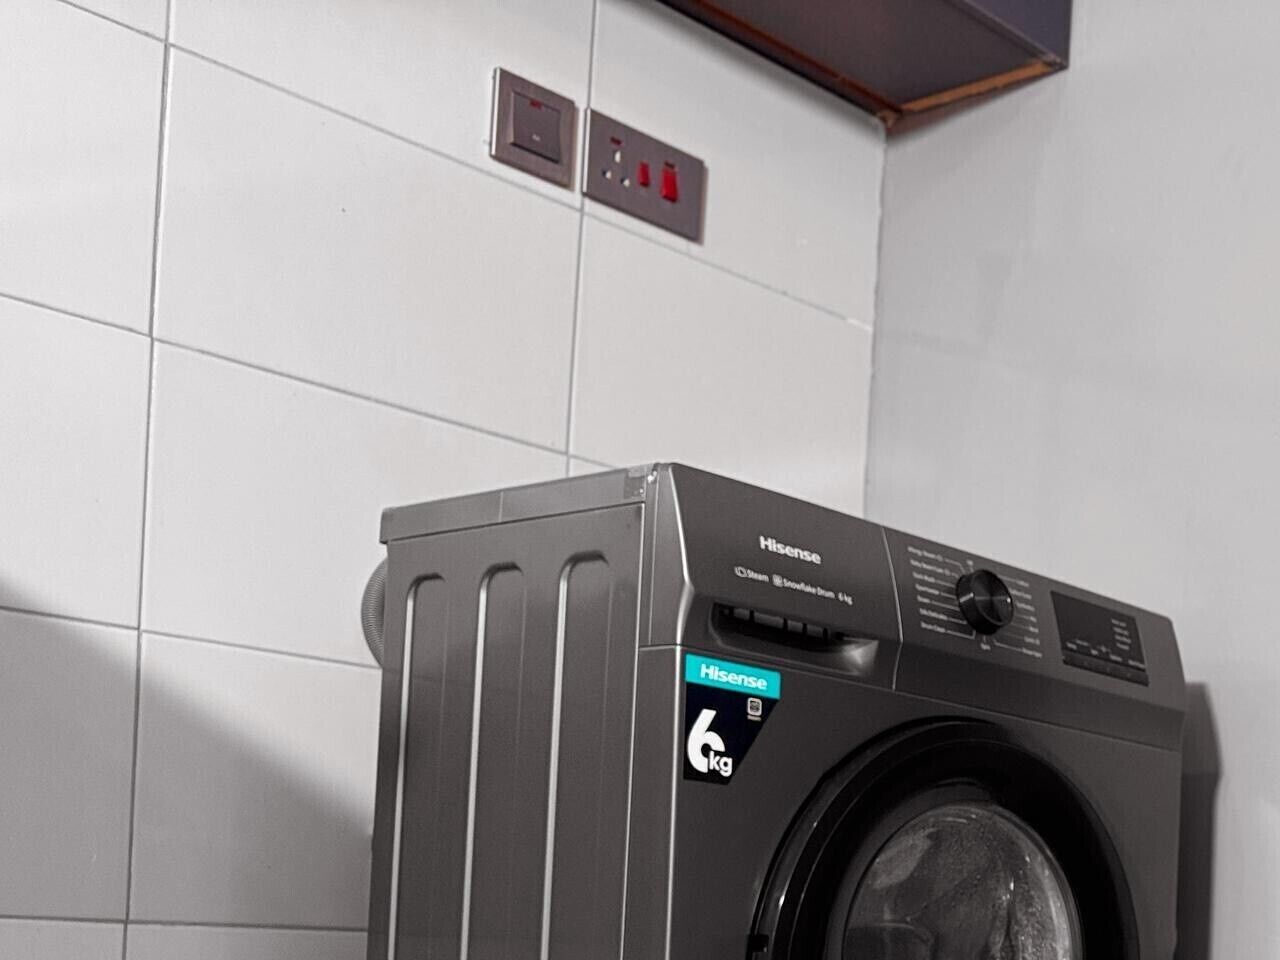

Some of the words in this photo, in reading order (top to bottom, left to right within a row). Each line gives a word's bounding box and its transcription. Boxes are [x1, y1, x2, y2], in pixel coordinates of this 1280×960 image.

[759, 535, 822, 565] Hisense
[747, 569, 769, 582] Steam
[817, 586, 836, 599] Drum
[838, 592, 844, 601] 6
[844, 592, 853, 605] kg
[700, 663, 768, 690] Hisense
